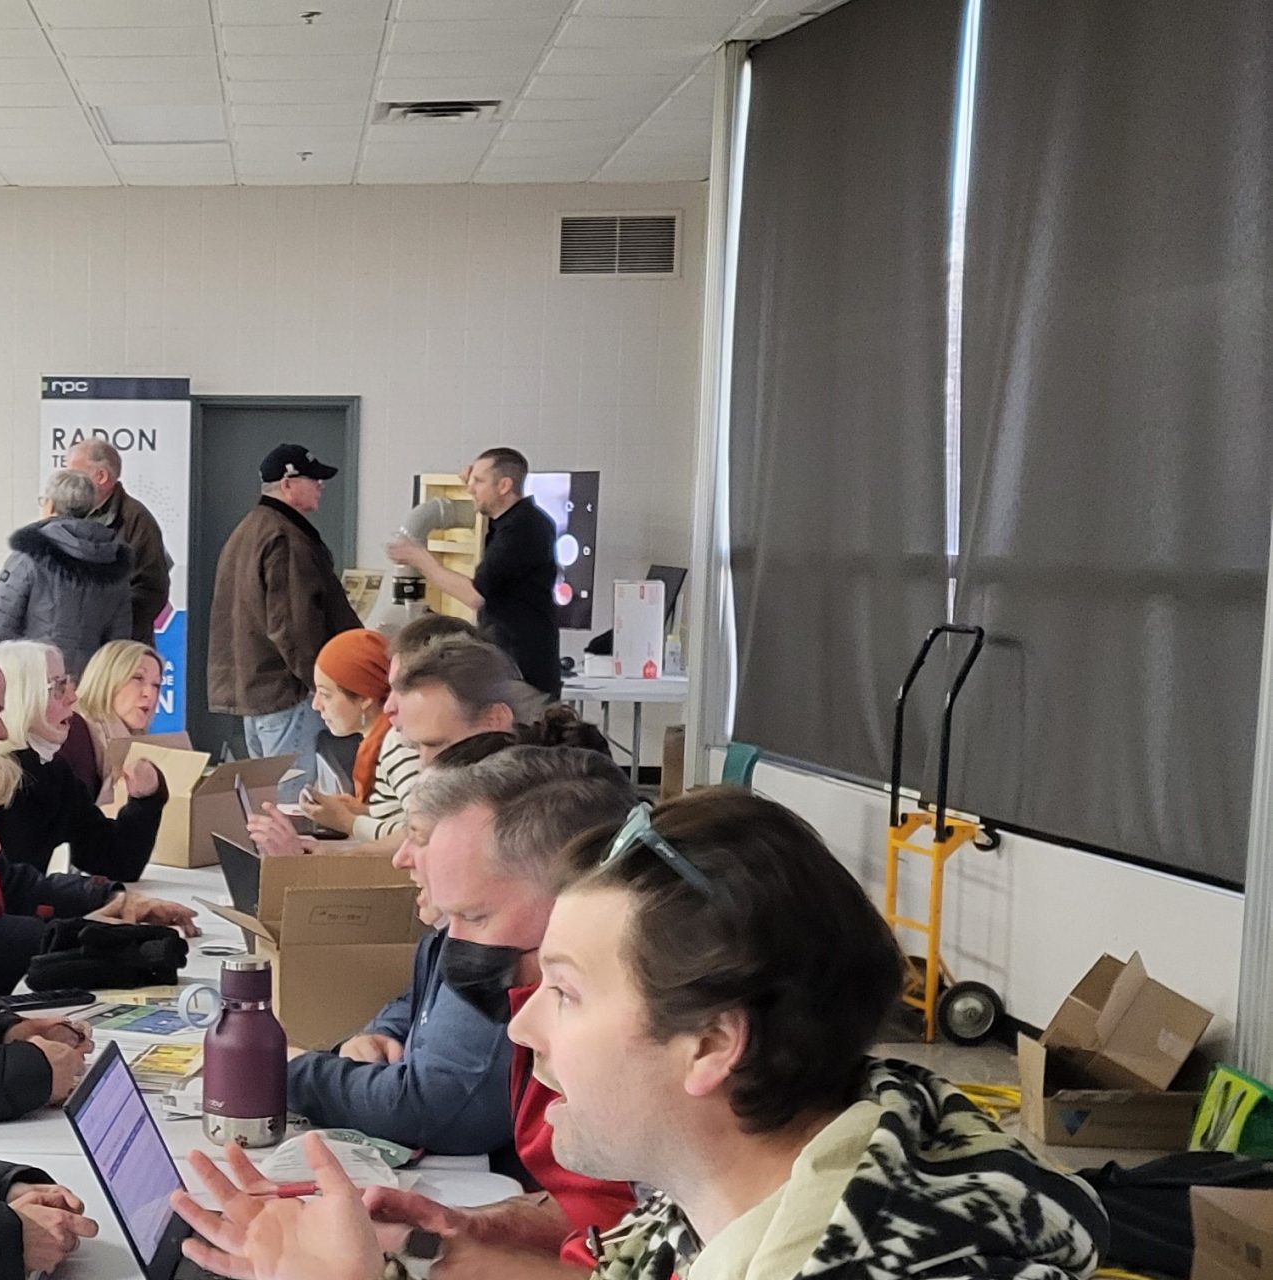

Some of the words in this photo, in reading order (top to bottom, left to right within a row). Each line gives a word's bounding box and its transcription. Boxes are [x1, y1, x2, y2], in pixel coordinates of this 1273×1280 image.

[51, 381, 88, 394] rpc
[52, 428, 157, 451] RADON
[52, 455, 68, 468] TE
